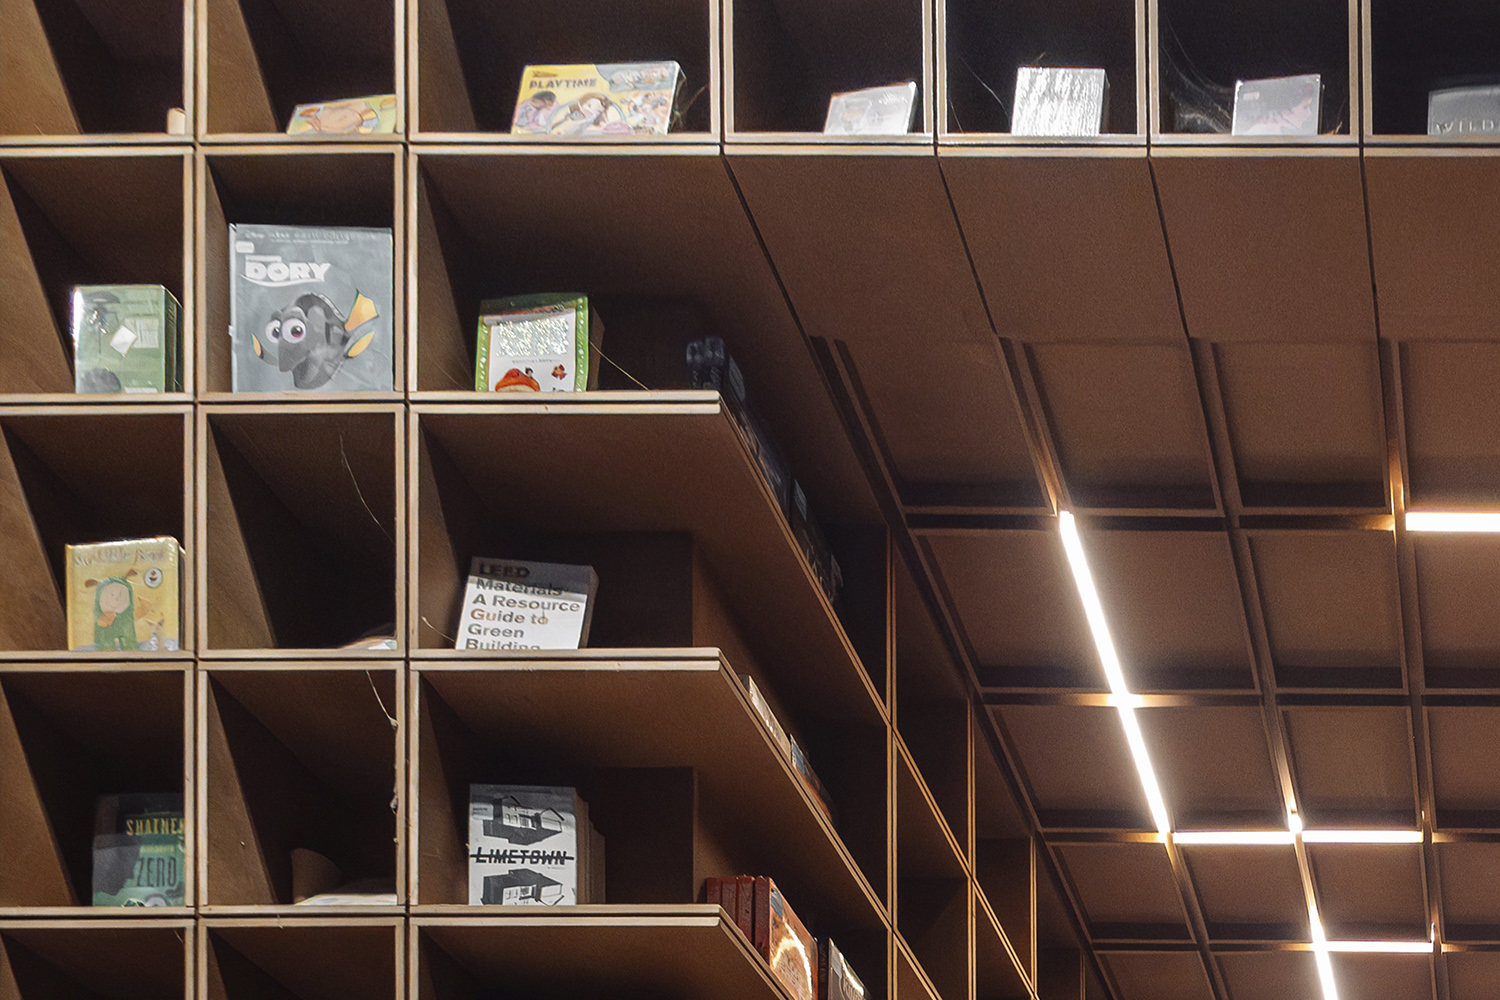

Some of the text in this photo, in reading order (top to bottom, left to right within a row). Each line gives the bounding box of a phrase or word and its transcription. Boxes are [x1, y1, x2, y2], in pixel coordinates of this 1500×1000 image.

[528, 78, 598, 89] PLAYTIME
[245, 262, 332, 282] DORY
[476, 578, 563, 596] Materials
[472, 593, 580, 612] A Resource
[470, 608, 549, 625] Guide to
[467, 623, 525, 639] Green
[475, 847, 567, 866] LIMETOWN
[137, 857, 176, 888] ZERO
